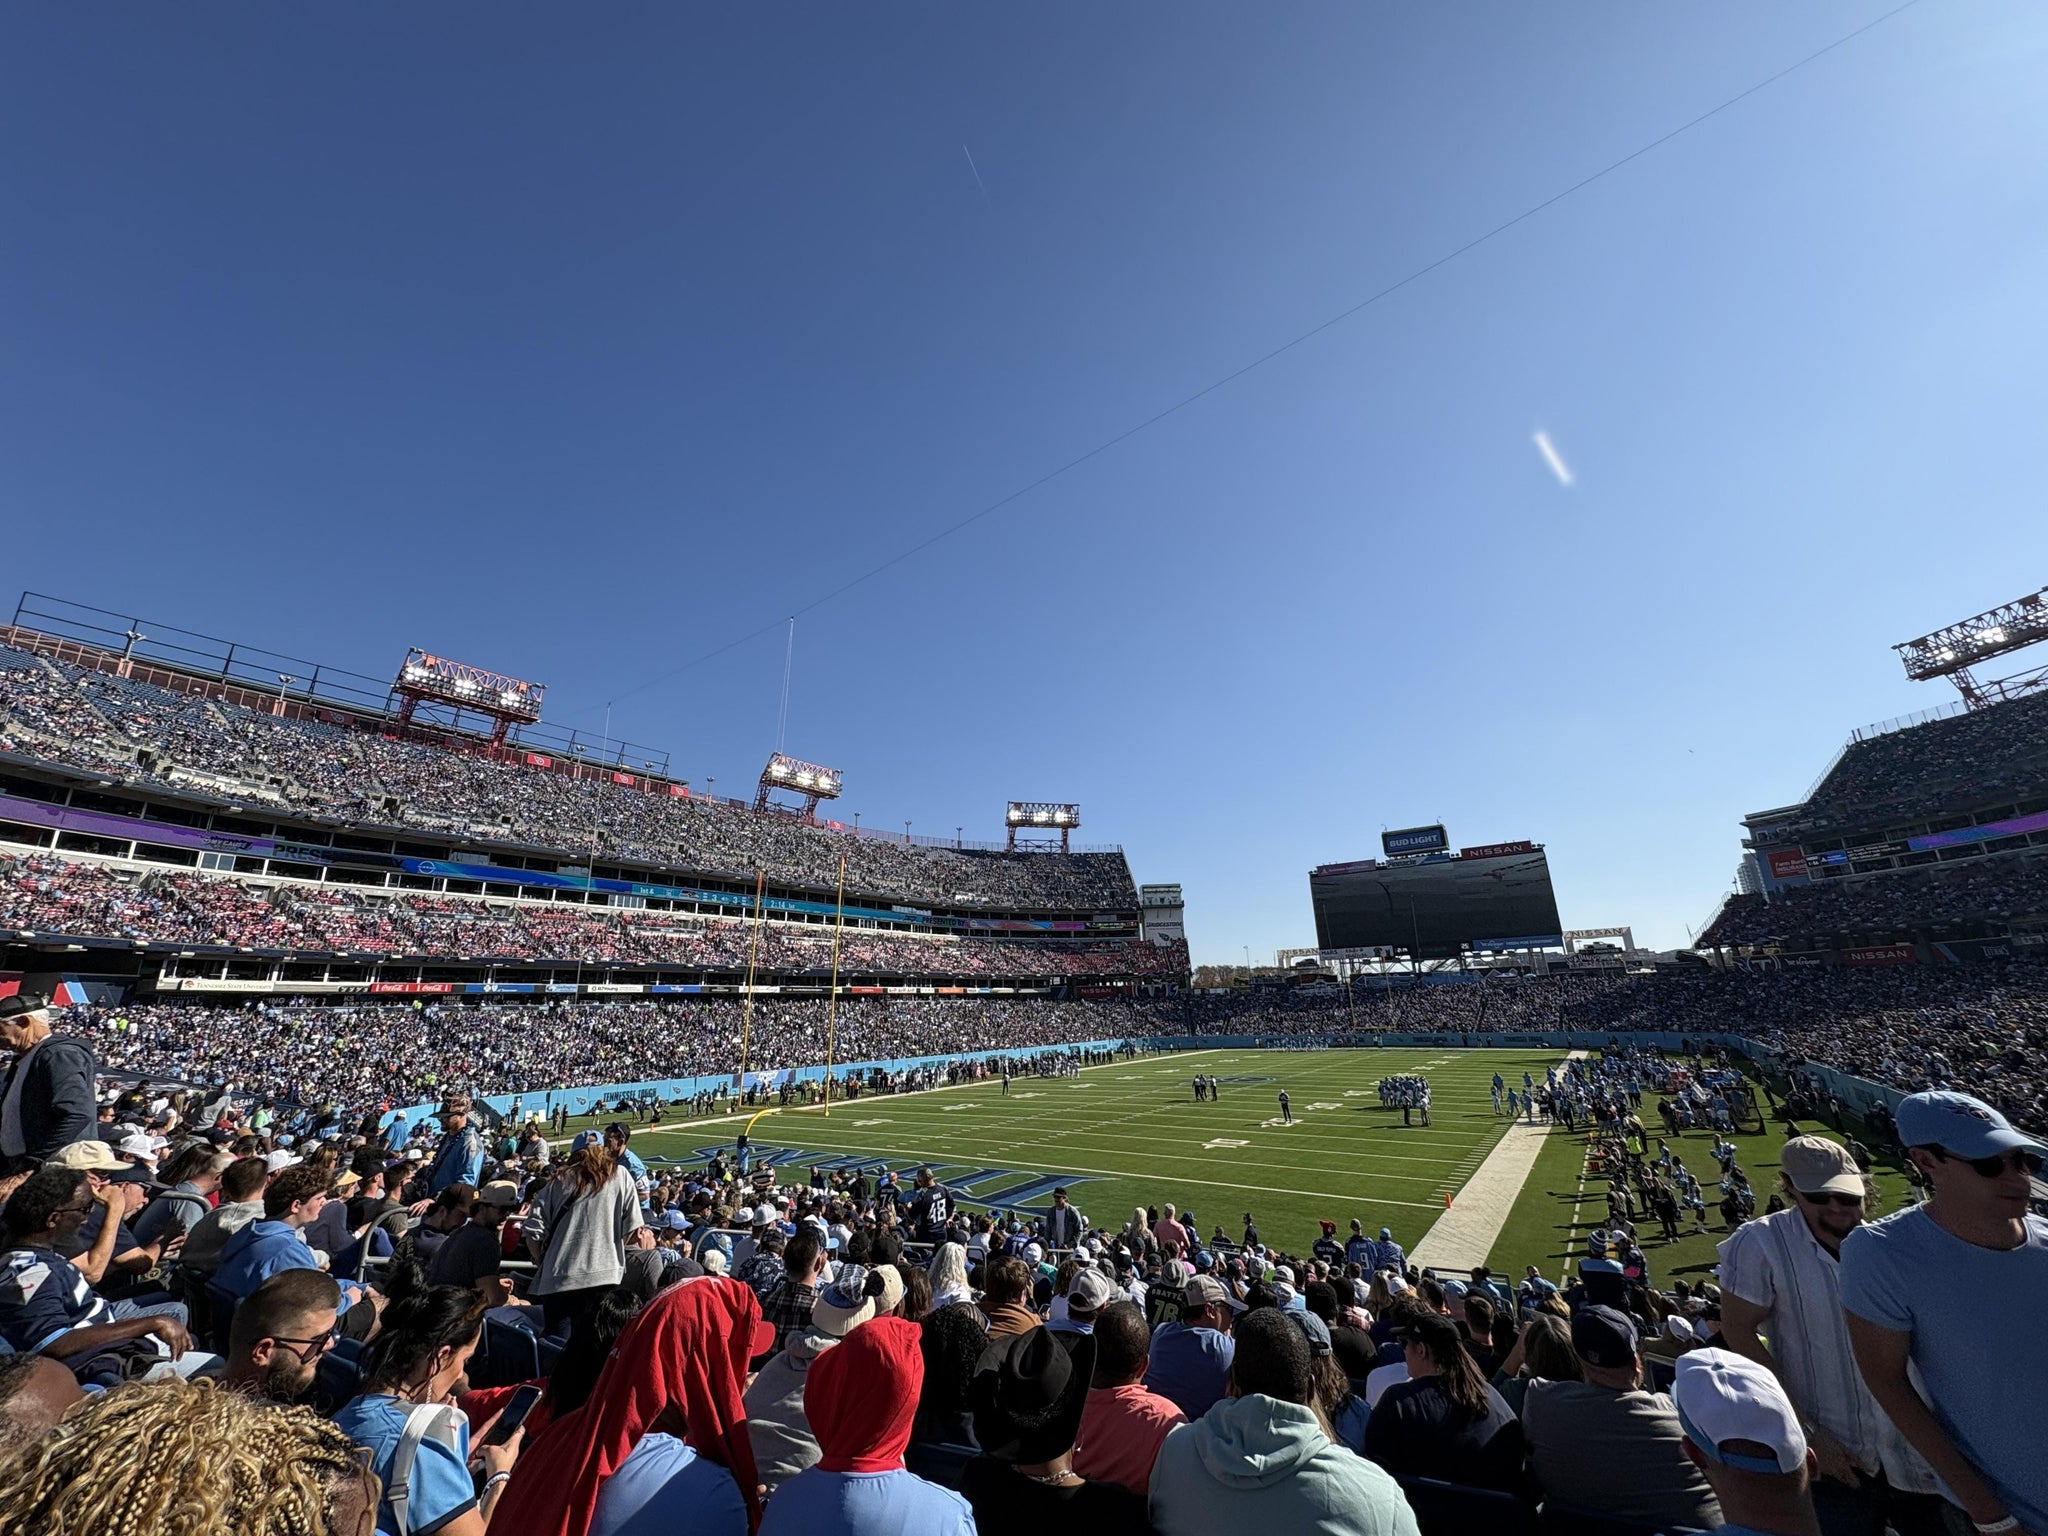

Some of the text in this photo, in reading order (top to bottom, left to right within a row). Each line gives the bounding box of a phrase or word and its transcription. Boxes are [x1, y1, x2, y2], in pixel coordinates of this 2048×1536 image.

[1389, 834, 1439, 848] BUD LIGHT
[1469, 844, 1523, 858] NISSAN
[1571, 927, 1623, 938] NISSAN
[1283, 948, 1319, 956] NISSAN
[1851, 949, 1908, 961] NISSAN
[196, 982, 227, 990] TENNESSEE
[603, 1089, 636, 1103] TENNESSEE
[926, 1197, 947, 1224] 48
[1360, 1252, 1370, 1270] 9
